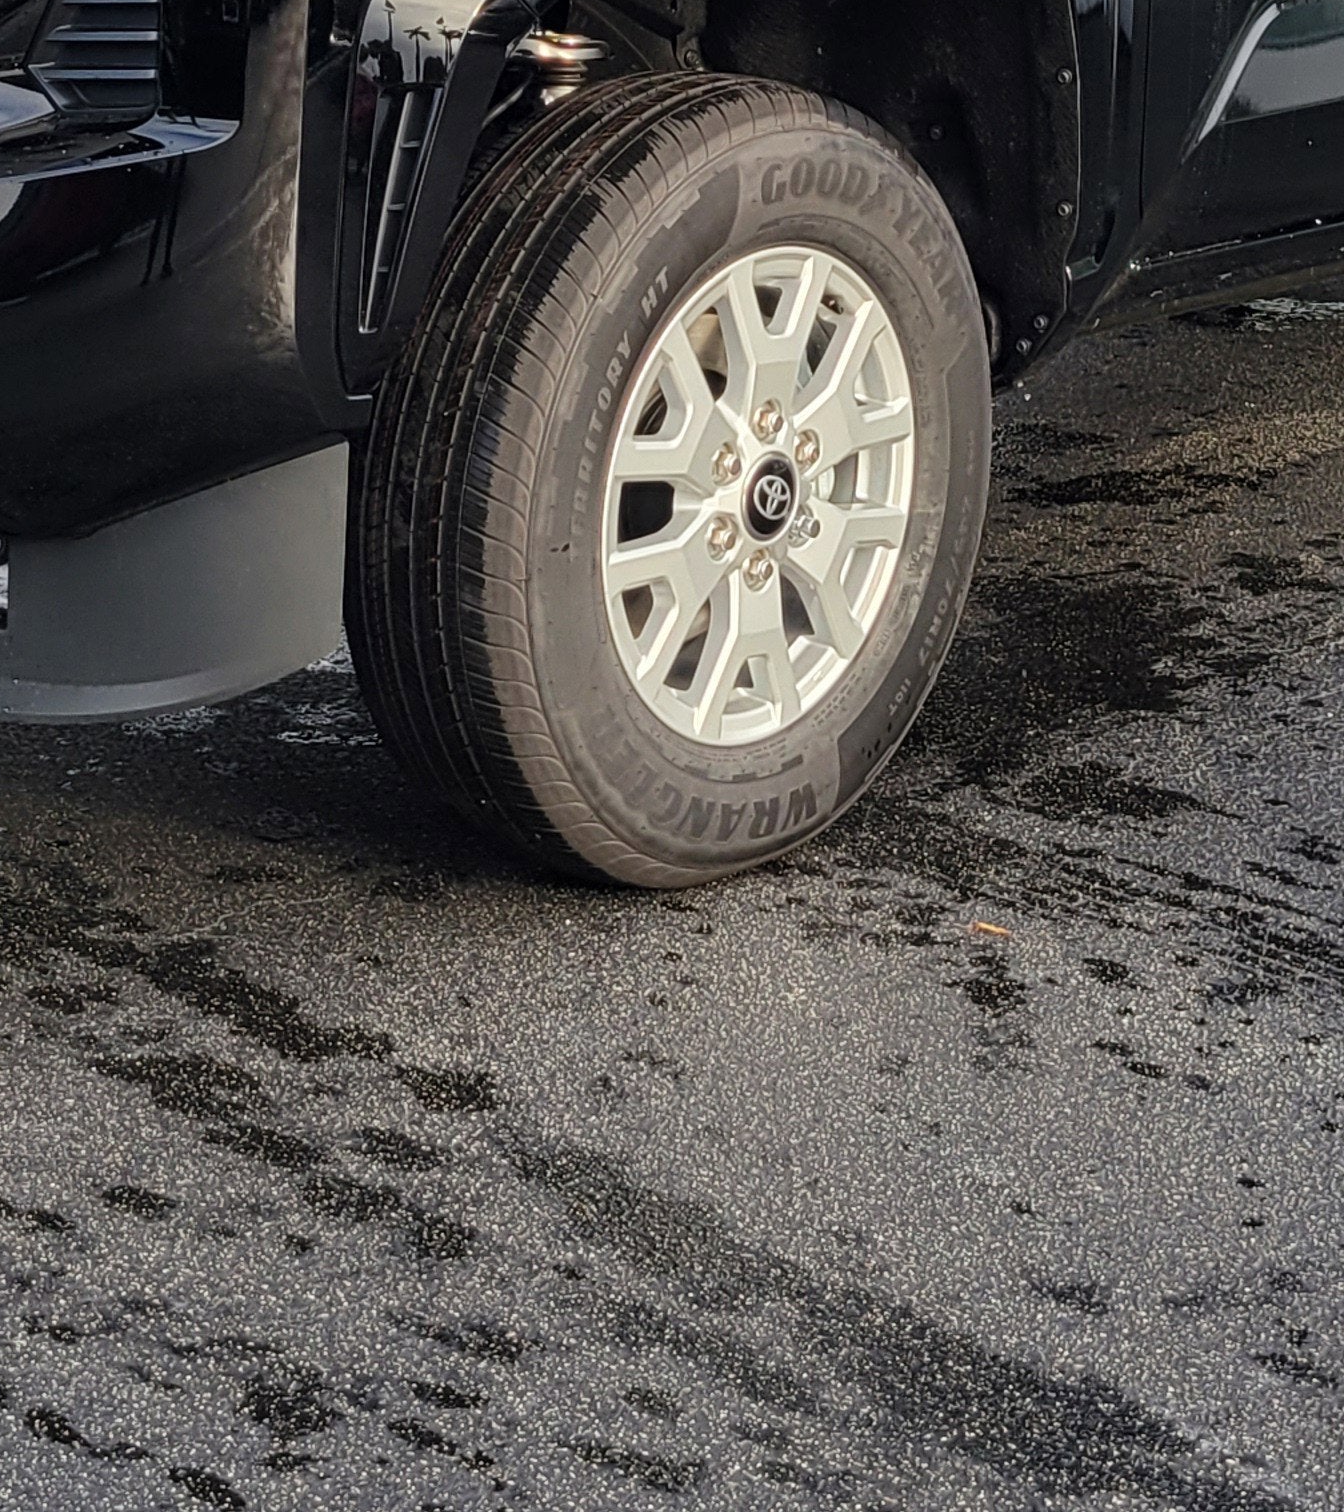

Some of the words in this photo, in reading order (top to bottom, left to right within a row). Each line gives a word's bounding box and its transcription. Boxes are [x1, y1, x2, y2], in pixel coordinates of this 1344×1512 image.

[760, 154, 972, 322] GOODYEAR
[569, 330, 633, 562] TERRITORY
[640, 265, 669, 319] HT
